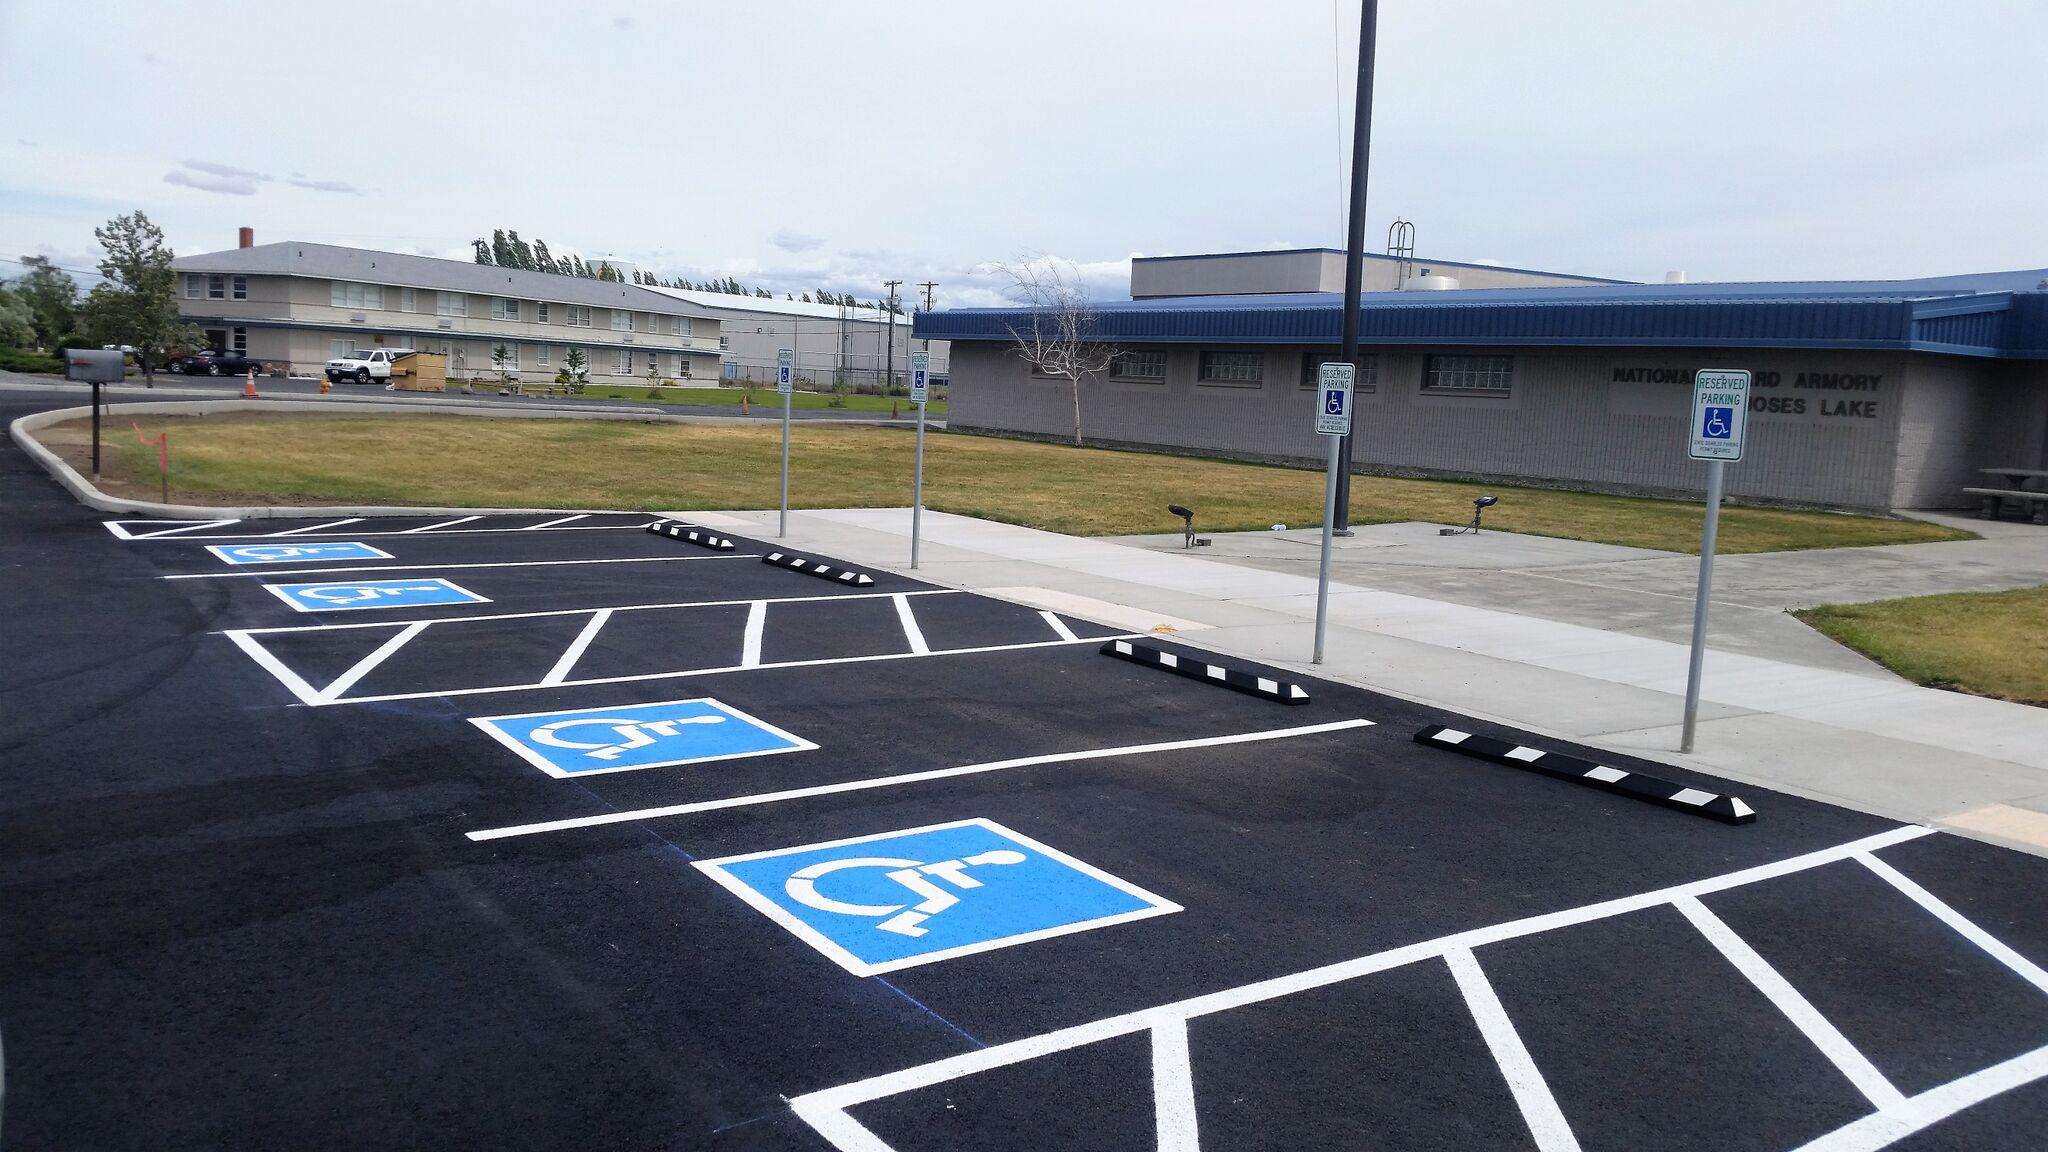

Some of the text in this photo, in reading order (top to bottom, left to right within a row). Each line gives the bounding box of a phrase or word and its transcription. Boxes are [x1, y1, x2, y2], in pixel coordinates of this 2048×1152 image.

[1323, 370, 1351, 379] RESERVED
[1613, 368, 1697, 385] NATIONA
[1793, 373, 1882, 391] ARMORY
[1323, 380, 1349, 390] PARKING
[1699, 377, 1745, 390] RESERVED
[1700, 393, 1741, 406] PARKING
[1820, 399, 1878, 419] LAKE
